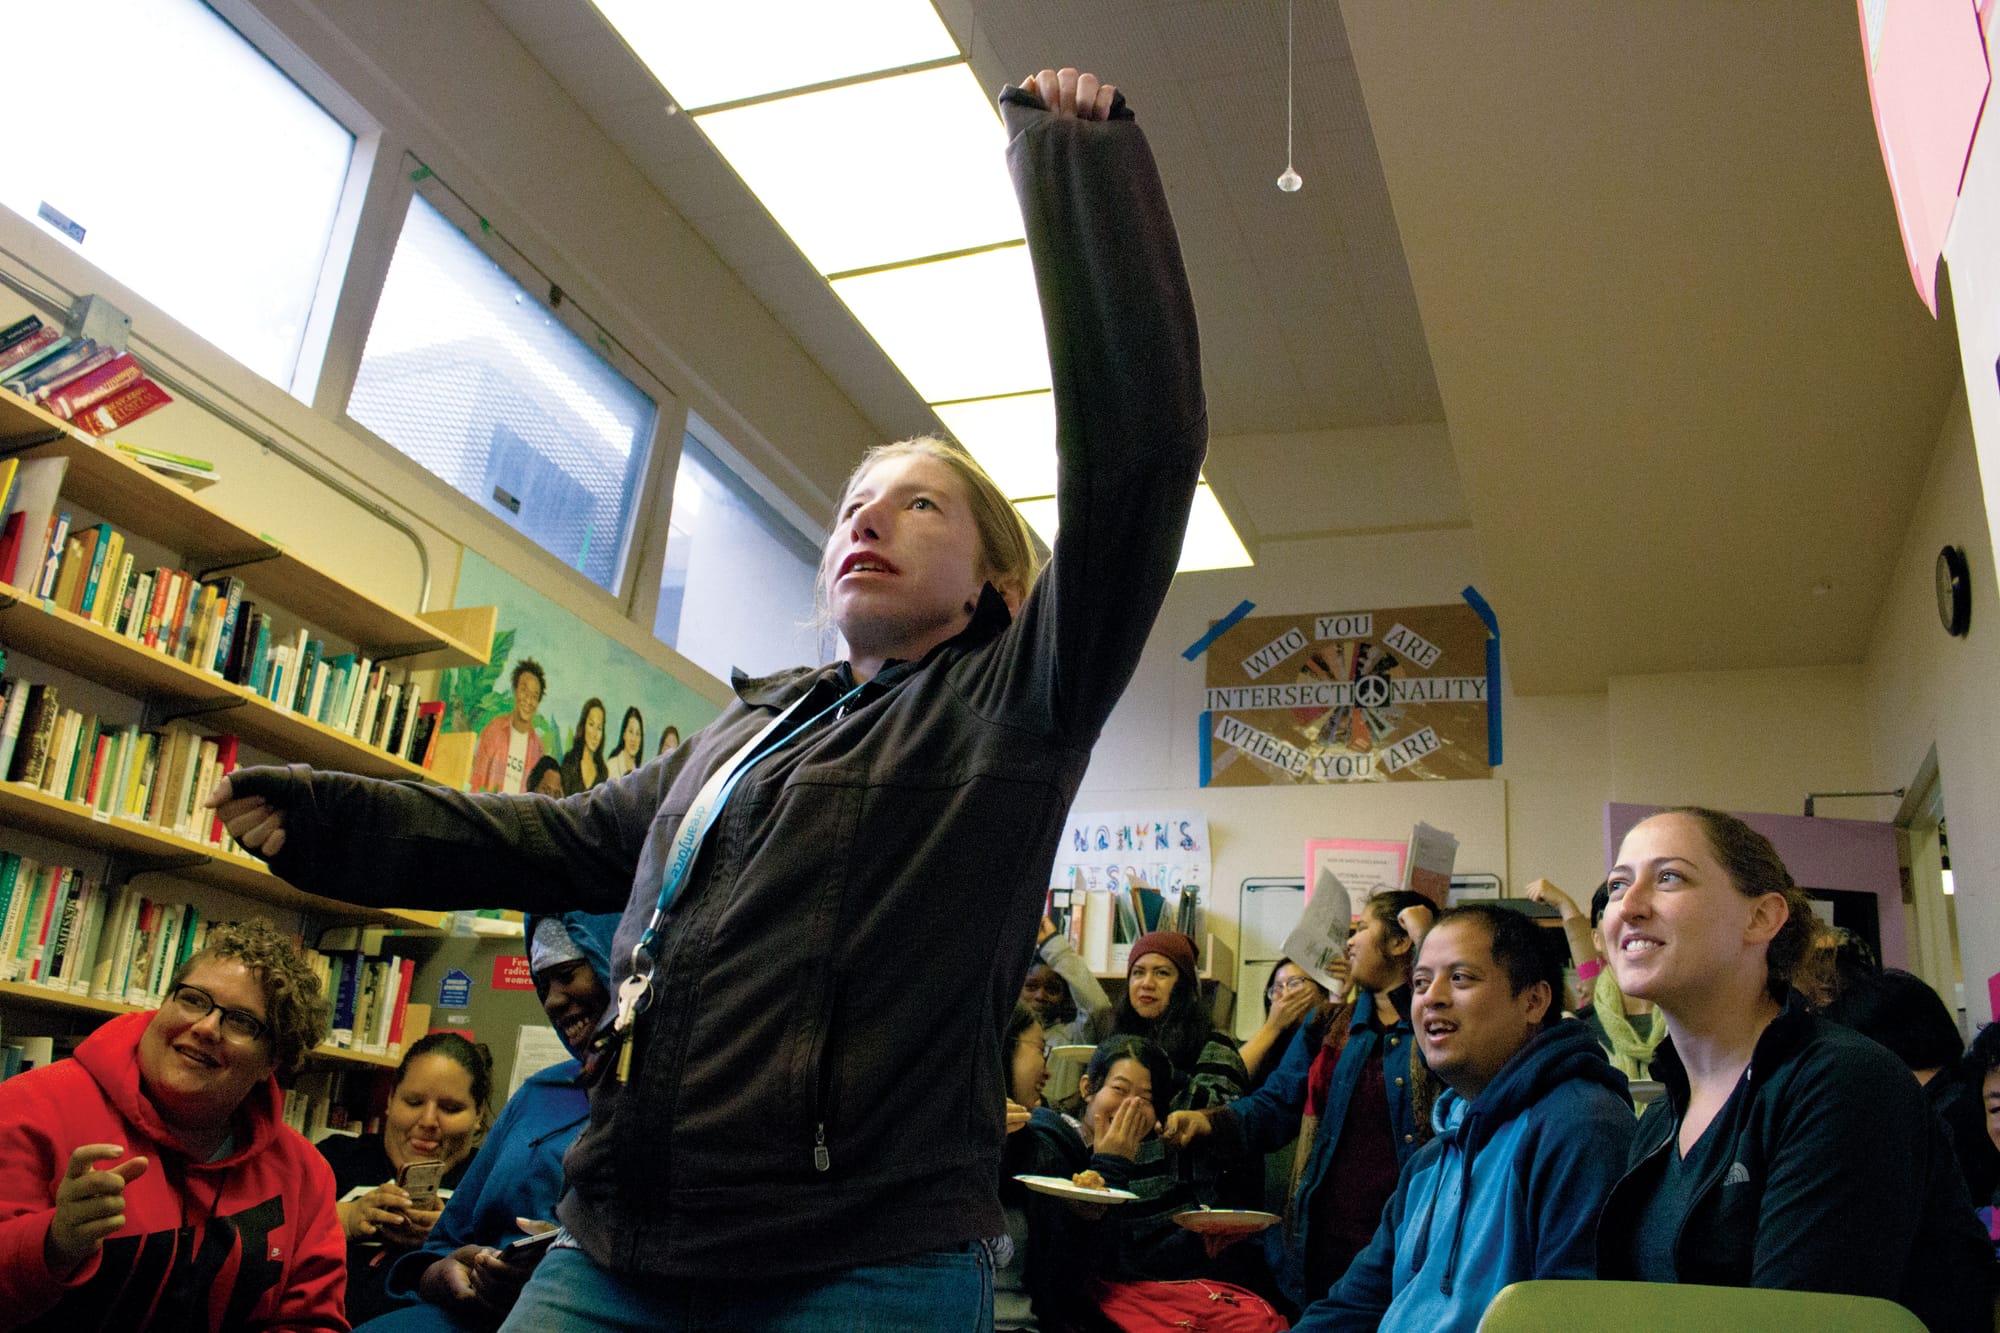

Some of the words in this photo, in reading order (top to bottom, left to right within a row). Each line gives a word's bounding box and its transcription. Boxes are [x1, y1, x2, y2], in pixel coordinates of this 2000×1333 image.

[1246, 632, 1305, 677] WHO
[1319, 615, 1370, 636] YOU
[1387, 631, 1438, 667] ARE
[1221, 719, 1309, 771] WHERE
[1318, 756, 1371, 776] YOU
[1390, 731, 1439, 769] ARE
[671, 806, 705, 879] dreamforce
